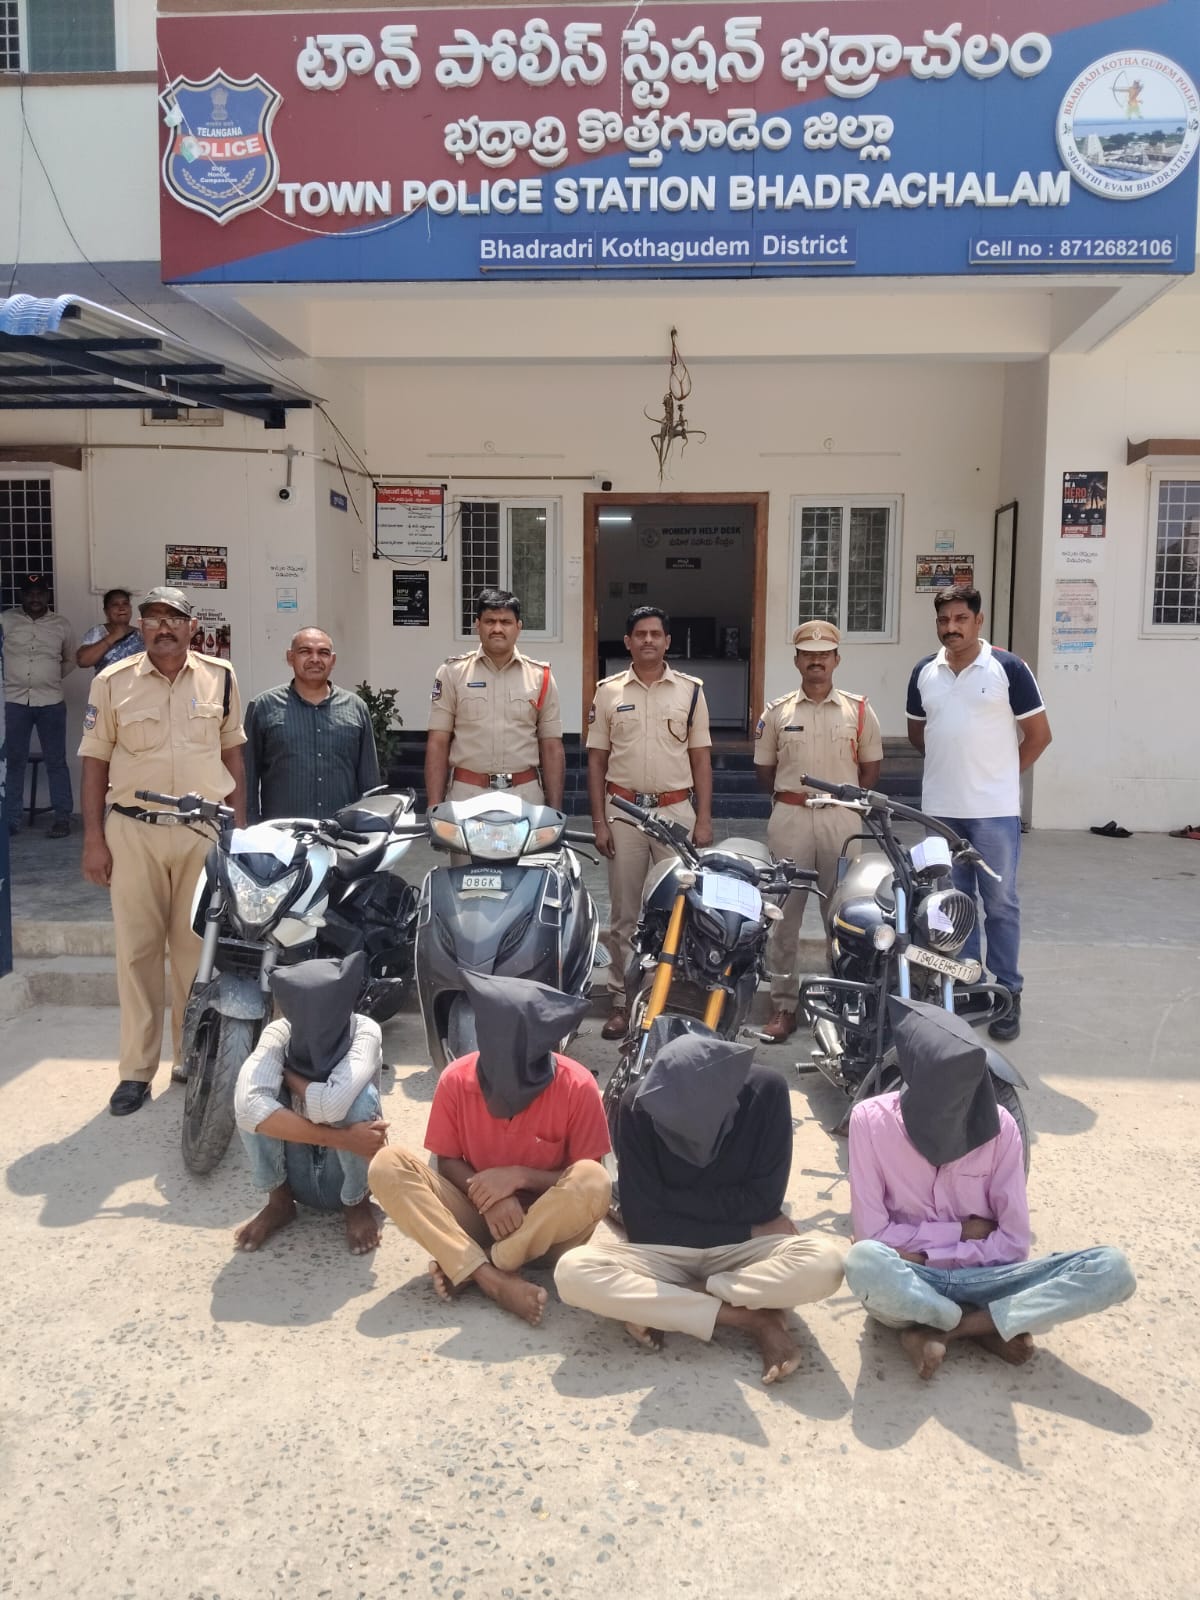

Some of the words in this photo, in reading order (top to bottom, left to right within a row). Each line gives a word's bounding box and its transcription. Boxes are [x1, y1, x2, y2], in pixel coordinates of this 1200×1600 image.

[297, 24, 421, 90] టౌన్
[435, 17, 607, 89] పోలీస్
[622, 16, 765, 109] స్టేషన్
[781, 22, 1052, 99] భద్రాచలం
[1064, 69, 1101, 115] BHADRADI
[1102, 57, 1139, 71] KOTHA
[1141, 57, 1177, 78] GUDEM
[1175, 76, 1199, 112] POLICE
[198, 126, 243, 137] TELANGANA
[444, 115, 569, 168] భద్రాద్రి
[577, 108, 792, 168] కొత్తగూడెం
[804, 111, 894, 161] జిల్లా
[197, 138, 262, 157] OLICE
[276, 182, 392, 215] TOWN
[403, 179, 543, 214] POLICE
[554, 175, 716, 213] STATION
[729, 171, 1070, 211] BHADRACHALAM
[1104, 182, 1133, 193] EVAM
[480, 238, 593, 260] Bhadradri
[601, 237, 750, 261] Kothagudem
[763, 234, 848, 255] District
[975, 240, 1012, 257] Cell
[1018, 243, 1042, 256] no
[1060, 239, 1172, 256] 8712682106
[1064, 487, 1087, 499] HERO
[662, 527, 697, 535] WOMEN'S
[699, 527, 719, 535] HELP
[720, 526, 741, 535] DESK
